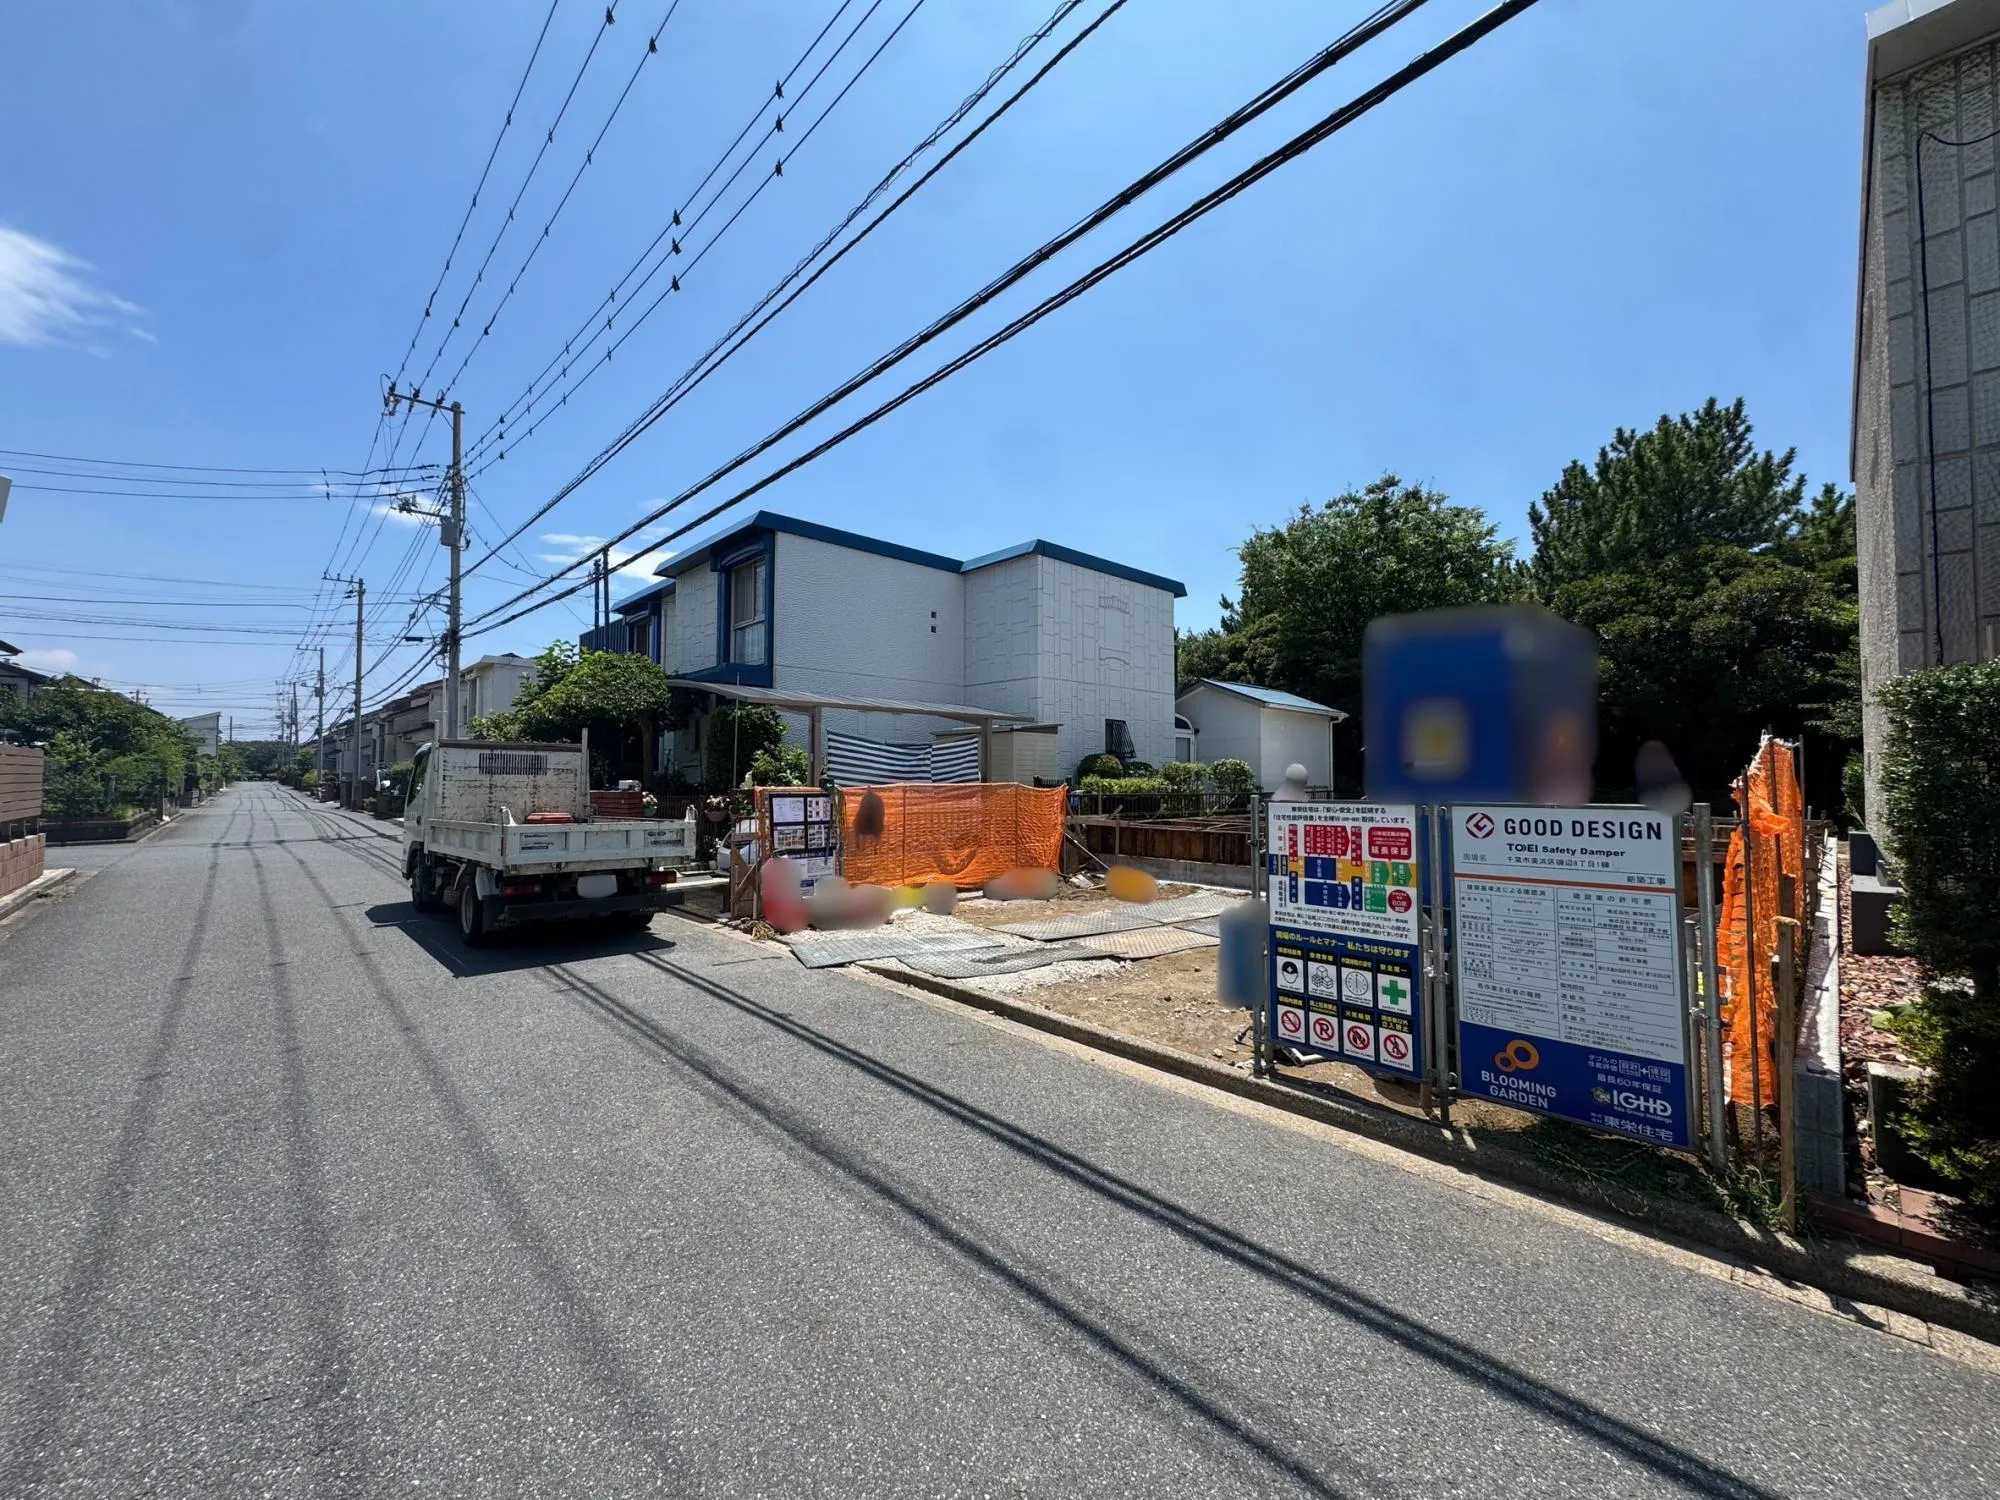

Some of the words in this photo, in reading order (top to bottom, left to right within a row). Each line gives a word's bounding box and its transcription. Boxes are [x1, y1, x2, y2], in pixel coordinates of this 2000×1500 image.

[1504, 818, 1562, 837] GOOD
[1571, 820, 1662, 841] DESIGN
[1542, 845, 1577, 857] Safety
[1580, 847, 1626, 858] Damper
[1481, 1070, 1557, 1098] BLOOMING
[1489, 1085, 1549, 1110] GARDEN
[1604, 1115, 1673, 1142] 東栄住宅
